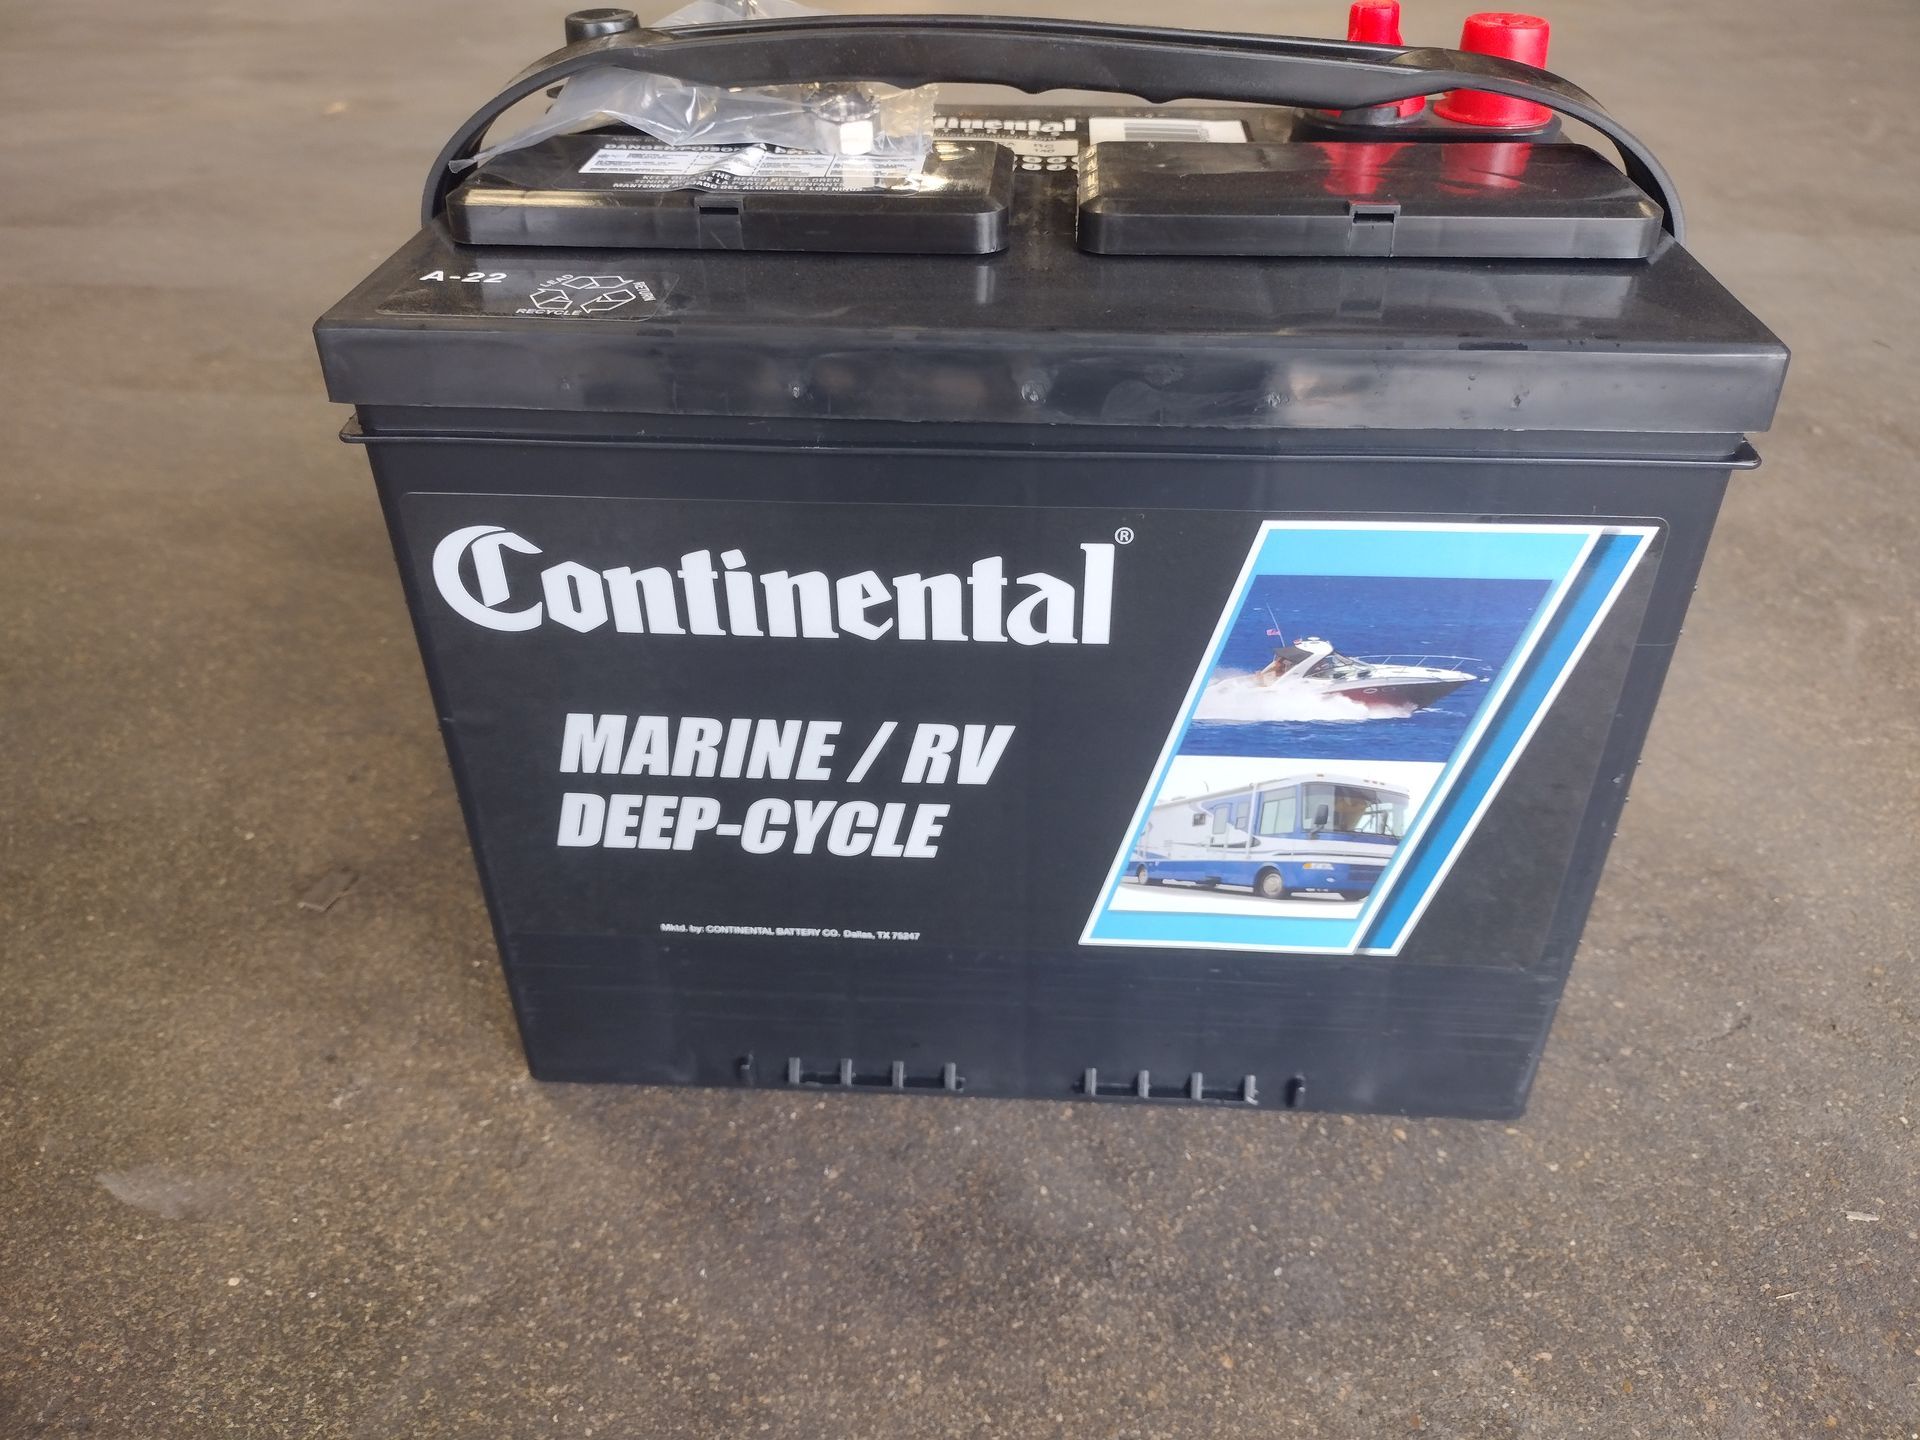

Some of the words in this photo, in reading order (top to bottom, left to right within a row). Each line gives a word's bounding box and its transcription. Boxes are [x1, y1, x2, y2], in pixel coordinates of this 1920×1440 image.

[712, 171, 731, 181] THE
[419, 270, 508, 284] A-22
[539, 274, 574, 288] LEAD
[632, 280, 657, 302] RETURN
[515, 307, 582, 317] RECYCLE
[560, 713, 843, 780] MARINE
[846, 721, 899, 784] /
[901, 723, 1016, 785] RV
[557, 793, 950, 859] DEEP-CYCLE
[705, 924, 774, 936] CONTINENTAL
[775, 927, 821, 937] BATTERY
[822, 928, 841, 938] CO.
[843, 929, 875, 940] Dallas,
[876, 930, 890, 940] TX
